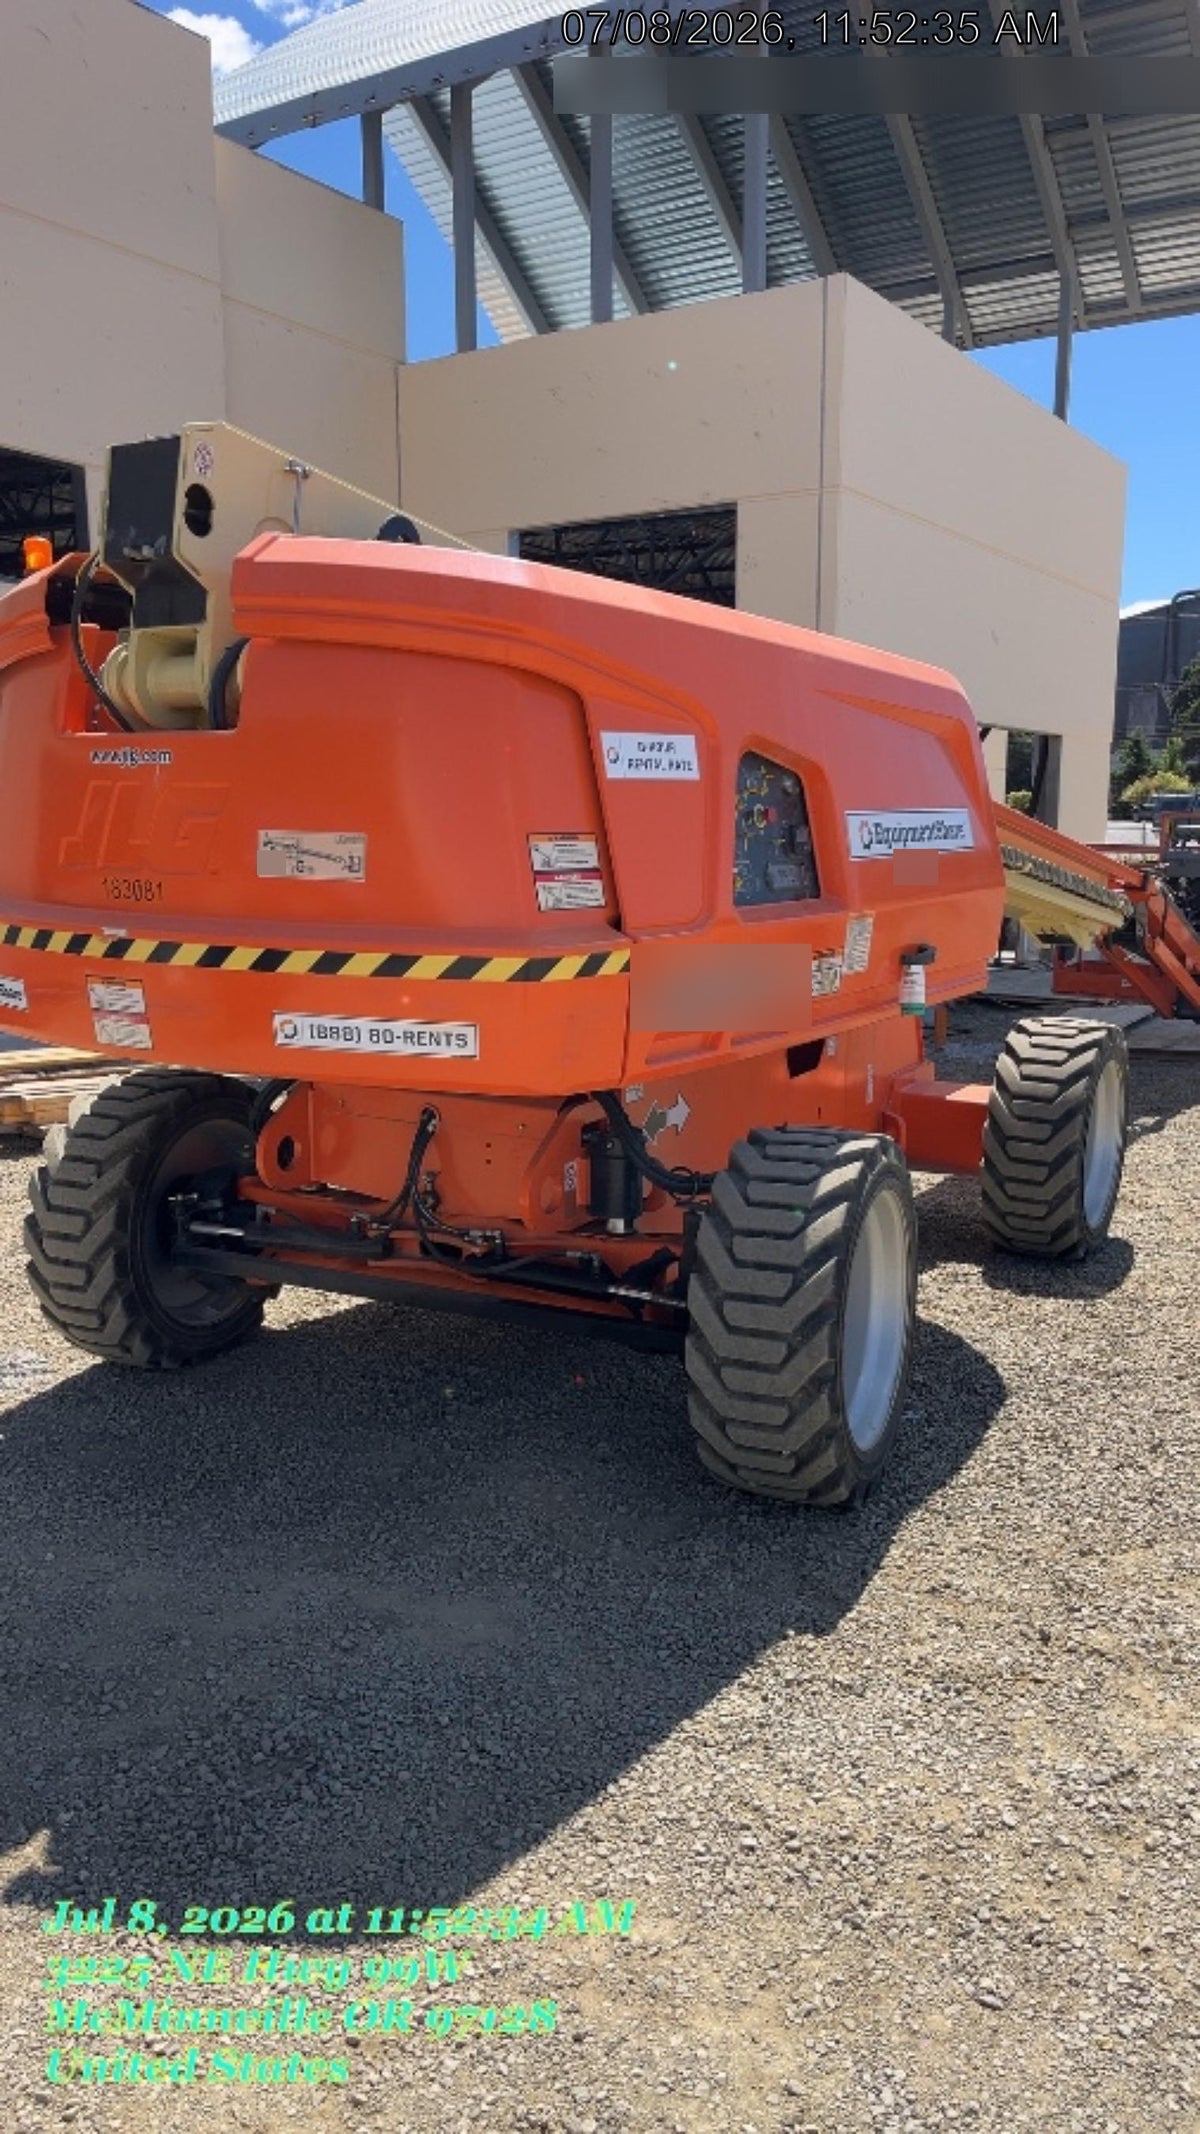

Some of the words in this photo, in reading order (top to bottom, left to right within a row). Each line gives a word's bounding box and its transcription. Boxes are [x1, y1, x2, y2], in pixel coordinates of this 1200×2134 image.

[90, 746, 173, 768] www.jlg.com
[58, 780, 231, 876] JLG
[101, 876, 164, 902] 183081
[309, 1023, 362, 1044] (888)
[369, 1028, 469, 1049] 80-RENTS
